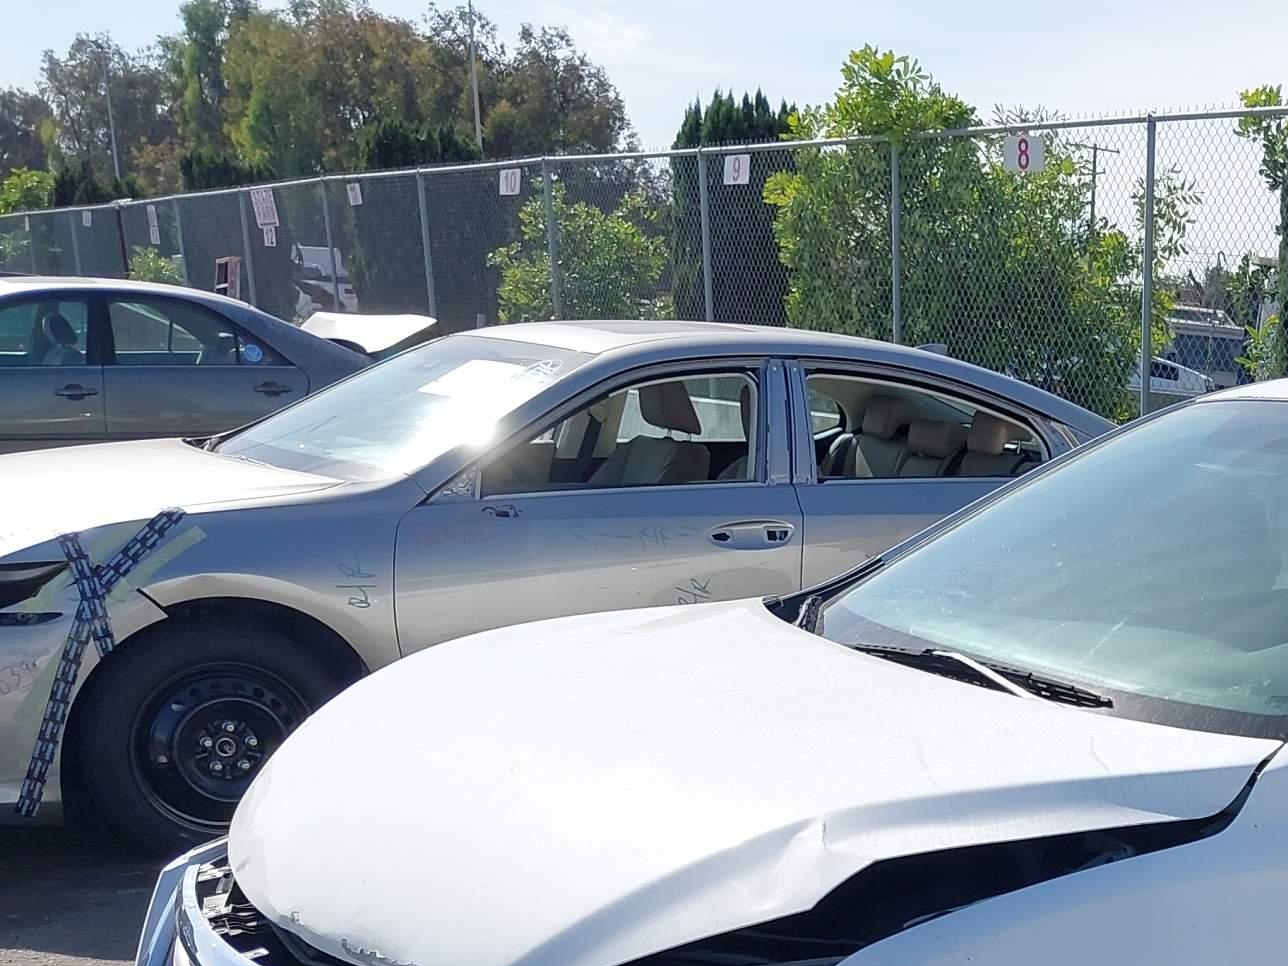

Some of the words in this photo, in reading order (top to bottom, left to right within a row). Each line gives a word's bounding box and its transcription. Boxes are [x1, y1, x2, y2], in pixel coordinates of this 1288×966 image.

[1018, 138, 1030, 170] 8
[503, 168, 517, 193] 10
[732, 156, 741, 182] 9
[265, 227, 275, 246] 12
